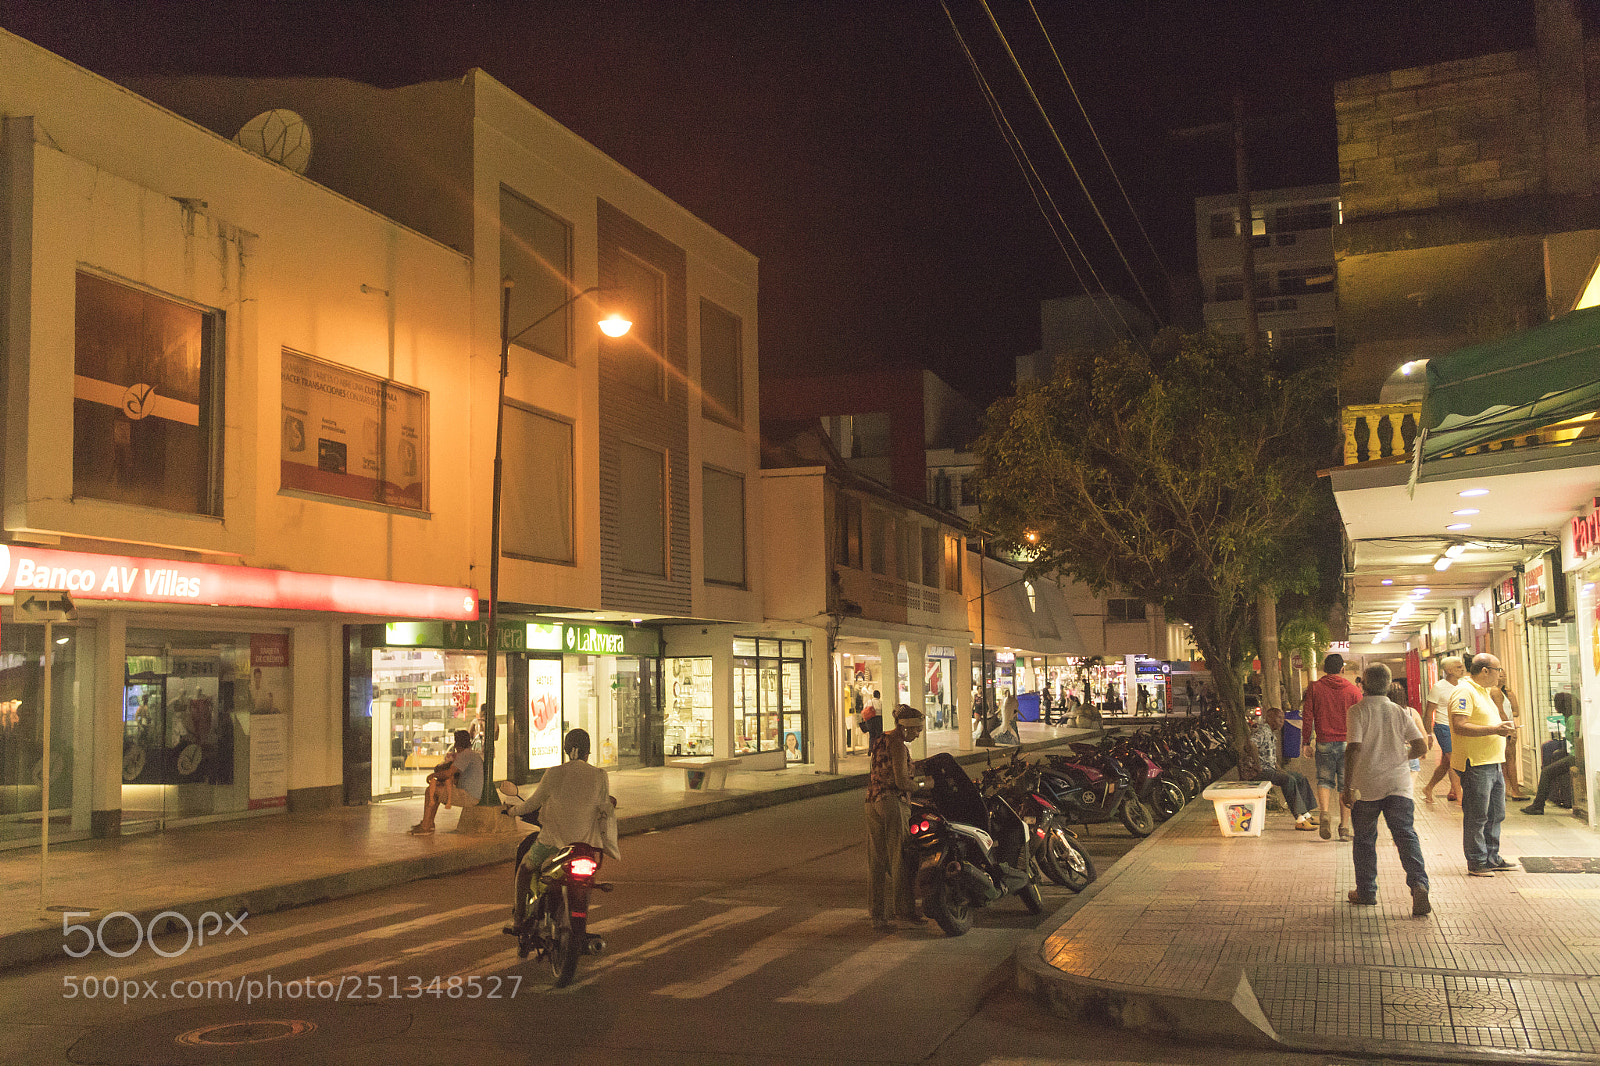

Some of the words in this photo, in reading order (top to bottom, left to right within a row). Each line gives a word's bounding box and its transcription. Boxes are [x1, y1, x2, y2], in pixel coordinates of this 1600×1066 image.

[14, 558, 96, 592] Banco
[101, 566, 138, 593] AV
[144, 569, 201, 598] Villas
[1458, 698, 1467, 710] 3
